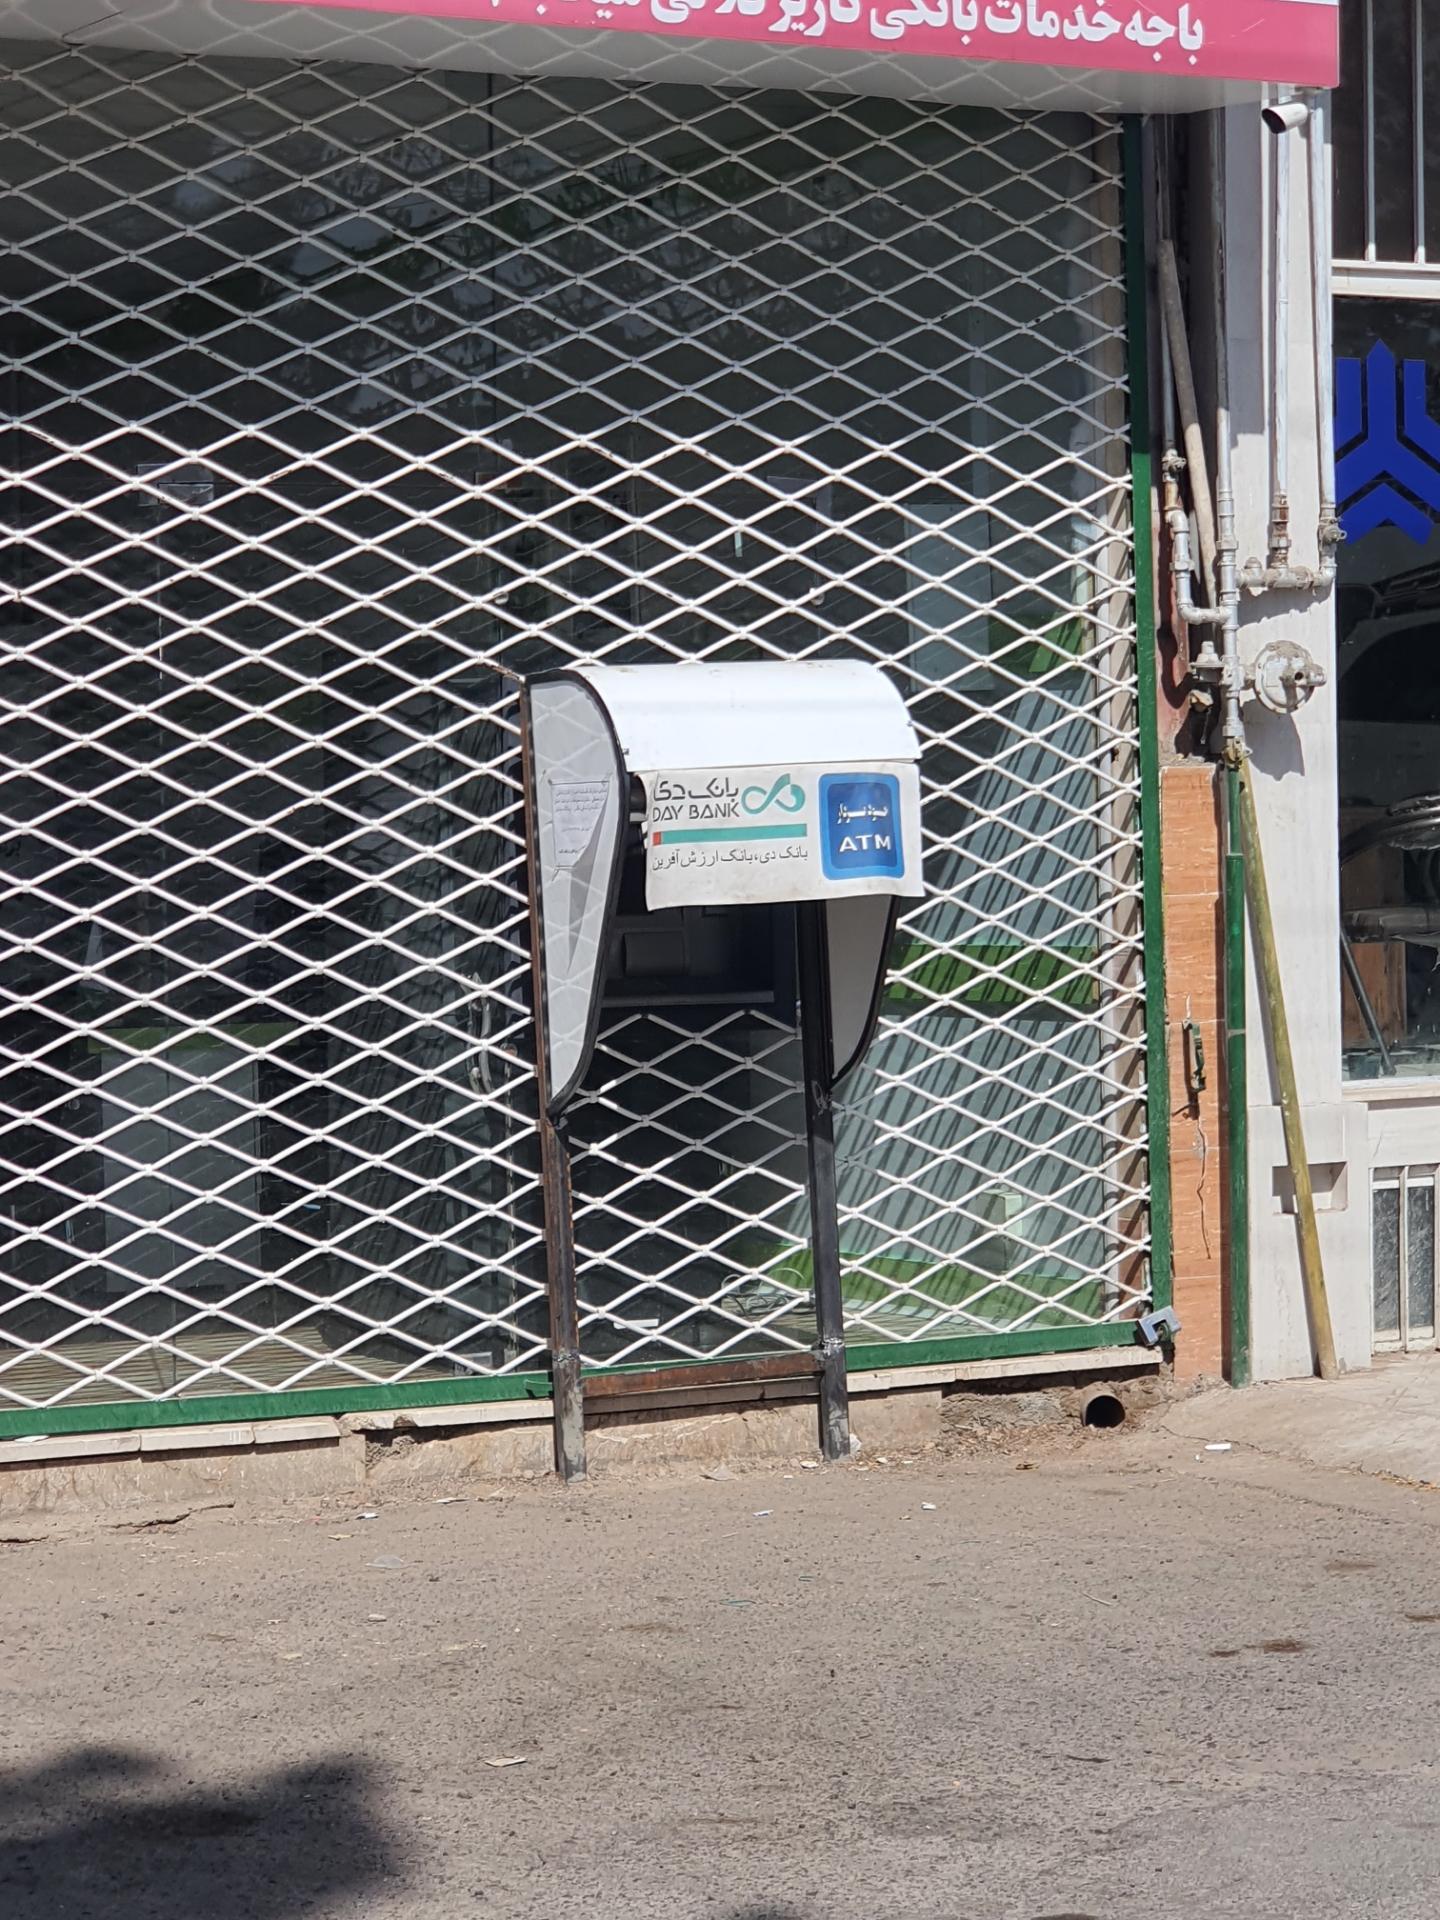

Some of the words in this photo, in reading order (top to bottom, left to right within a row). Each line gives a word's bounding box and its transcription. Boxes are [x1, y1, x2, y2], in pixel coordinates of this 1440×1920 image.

[984, 0, 1122, 42] خدمات
[1124, 3, 1204, 65] باجه
[654, 780, 686, 801] دی
[687, 777, 739, 803] بانک
[652, 804, 684, 823] DAY
[689, 801, 740, 820] BANK
[778, 845, 808, 860] بانک
[839, 833, 892, 853] ATM
[651, 848, 680, 871] آفرین
[680, 850, 719, 868] ارزش
[720, 848, 753, 864] بانک
